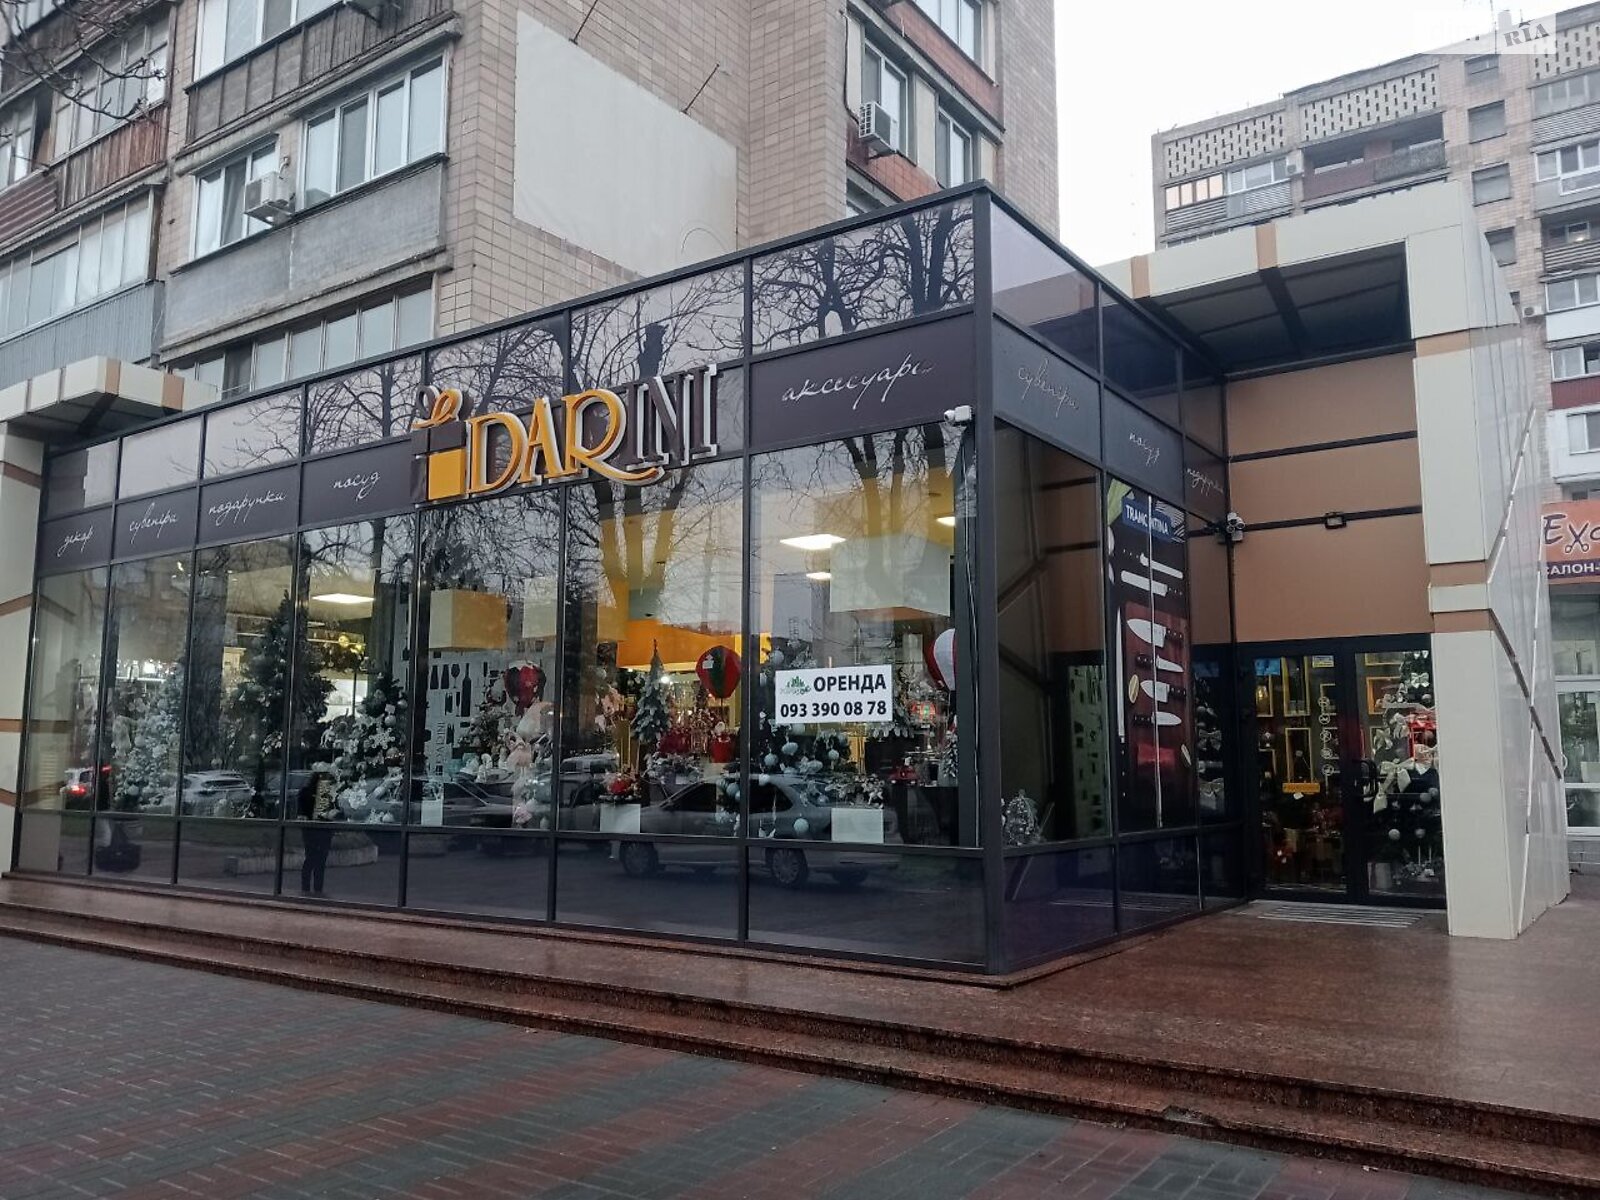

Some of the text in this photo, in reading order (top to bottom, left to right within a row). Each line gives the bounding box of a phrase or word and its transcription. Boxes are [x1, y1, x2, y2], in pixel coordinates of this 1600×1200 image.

[465, 363, 718, 494] DARINI
[333, 471, 381, 502] посуд
[129, 502, 178, 544] сувеніри
[208, 489, 287, 526] подарунки
[1125, 504, 1169, 535] TRAMCNTINA
[813, 673, 887, 694] ОРЕНДА
[780, 700, 887, 718] 093 390 08 78
